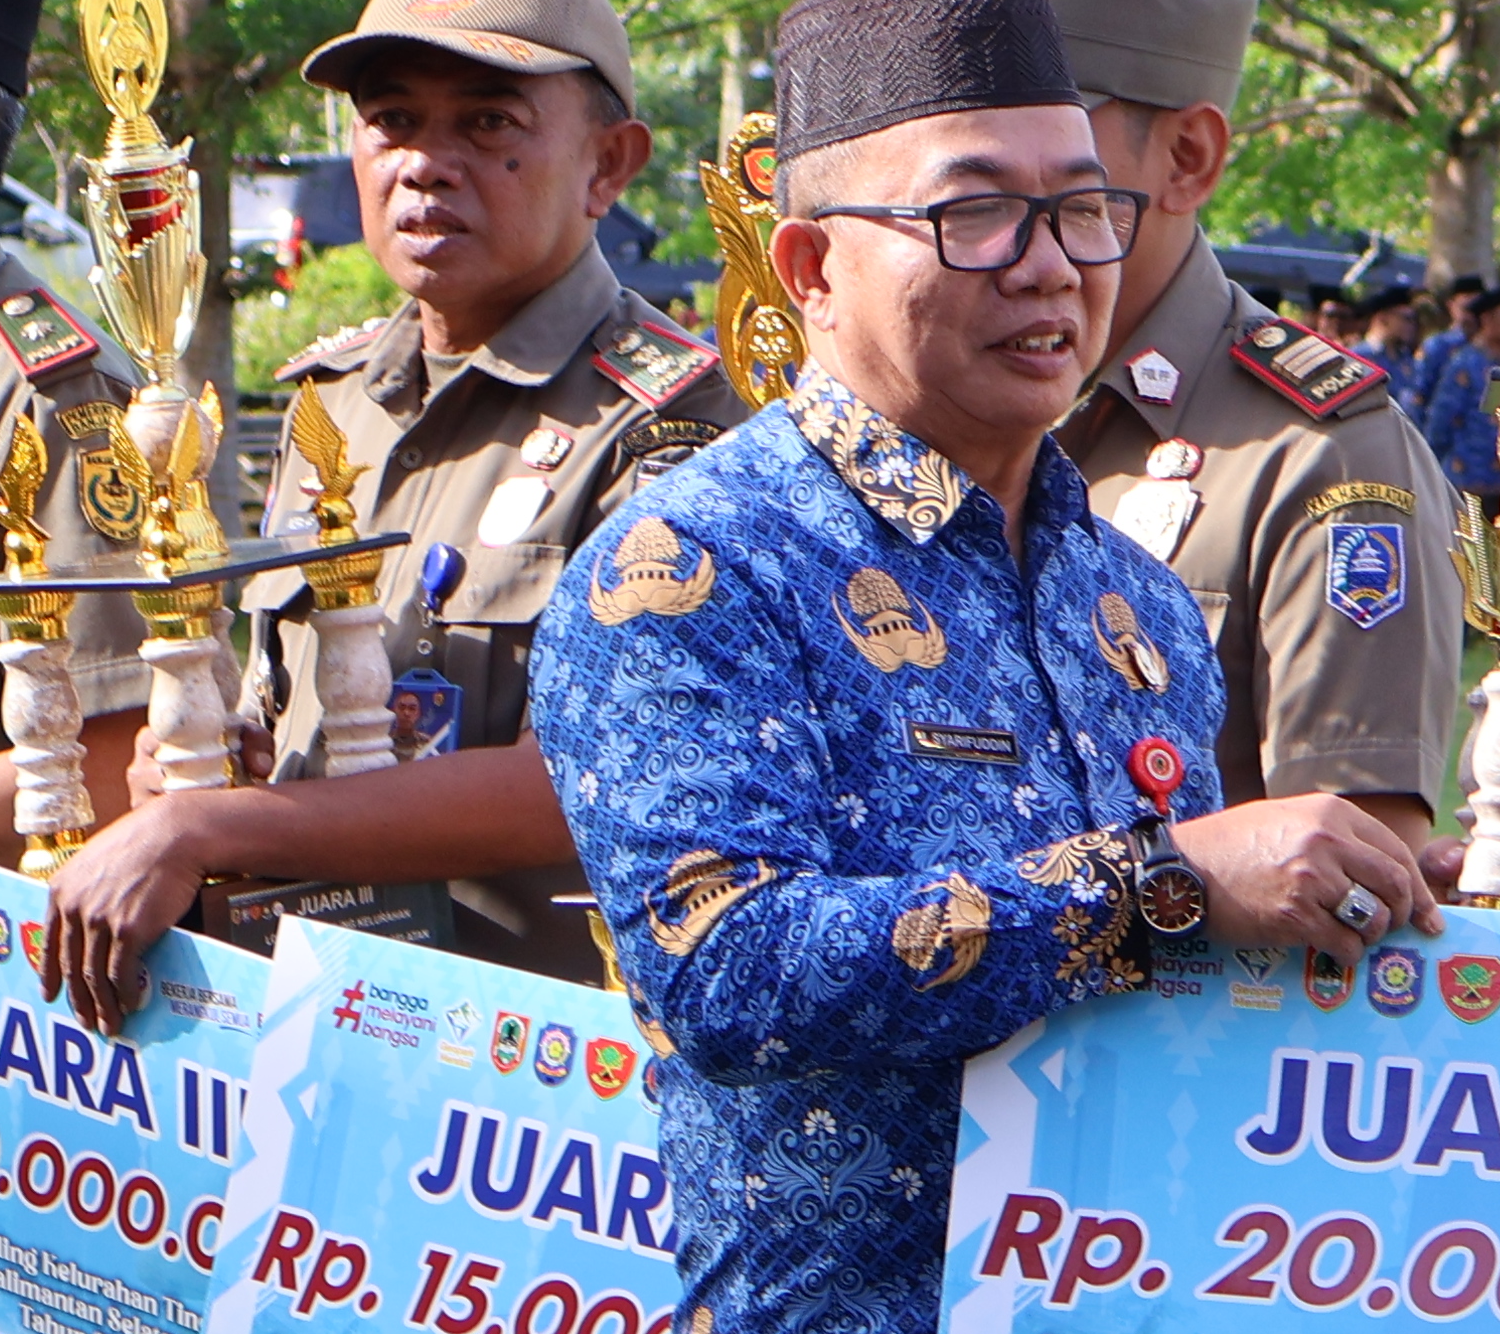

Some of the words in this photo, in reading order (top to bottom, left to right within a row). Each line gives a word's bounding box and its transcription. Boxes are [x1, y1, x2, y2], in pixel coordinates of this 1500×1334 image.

[363, 1002, 438, 1033] melayani
[369, 981, 429, 1013] bangga
[362, 1019, 420, 1049] bangsa
[417, 1108, 679, 1255] JUAR
[251, 1210, 379, 1315] Rp.
[979, 1192, 1166, 1305] Rp.
[41, 1250, 158, 1313] Kelurahan
